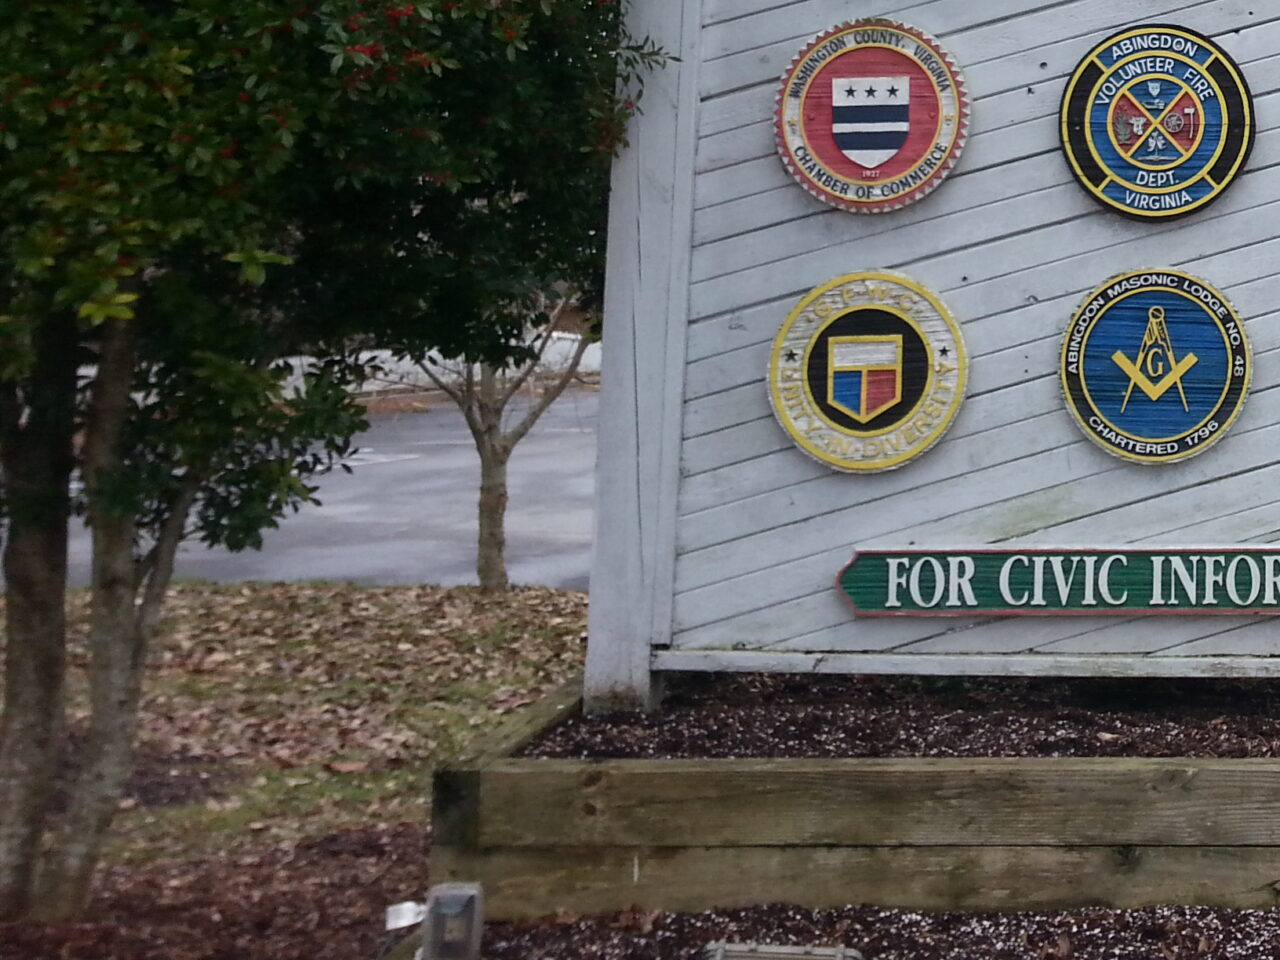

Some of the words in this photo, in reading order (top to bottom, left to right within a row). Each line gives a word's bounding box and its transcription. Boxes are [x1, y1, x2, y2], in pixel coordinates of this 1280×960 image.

[789, 36, 847, 98] WASHINGTON
[913, 45, 950, 92] VIRGINIA
[1112, 35, 1198, 59] ABINGDON
[1095, 58, 1174, 104] VOLUNTEER
[1183, 68, 1214, 101] FIRE
[794, 146, 849, 195] CHAMBER
[856, 186, 874, 199] OF
[881, 143, 948, 197] COMMERCE
[1136, 171, 1179, 186] DEPT.
[1124, 191, 1192, 209] VIRGINIA
[1068, 298, 1105, 374] ABINGDON
[1108, 275, 1178, 298] MASONIC
[1183, 281, 1227, 319] LODGE
[1226, 323, 1240, 348] NO.
[1234, 356, 1243, 376] 48
[1147, 348, 1164, 377] G
[863, 362, 955, 457] DIVERSITY
[1089, 416, 1178, 454] CHARTERED
[1184, 421, 1219, 446] 1796
[885, 556, 978, 607] FOR
[999, 555, 1128, 606] CIVIC
